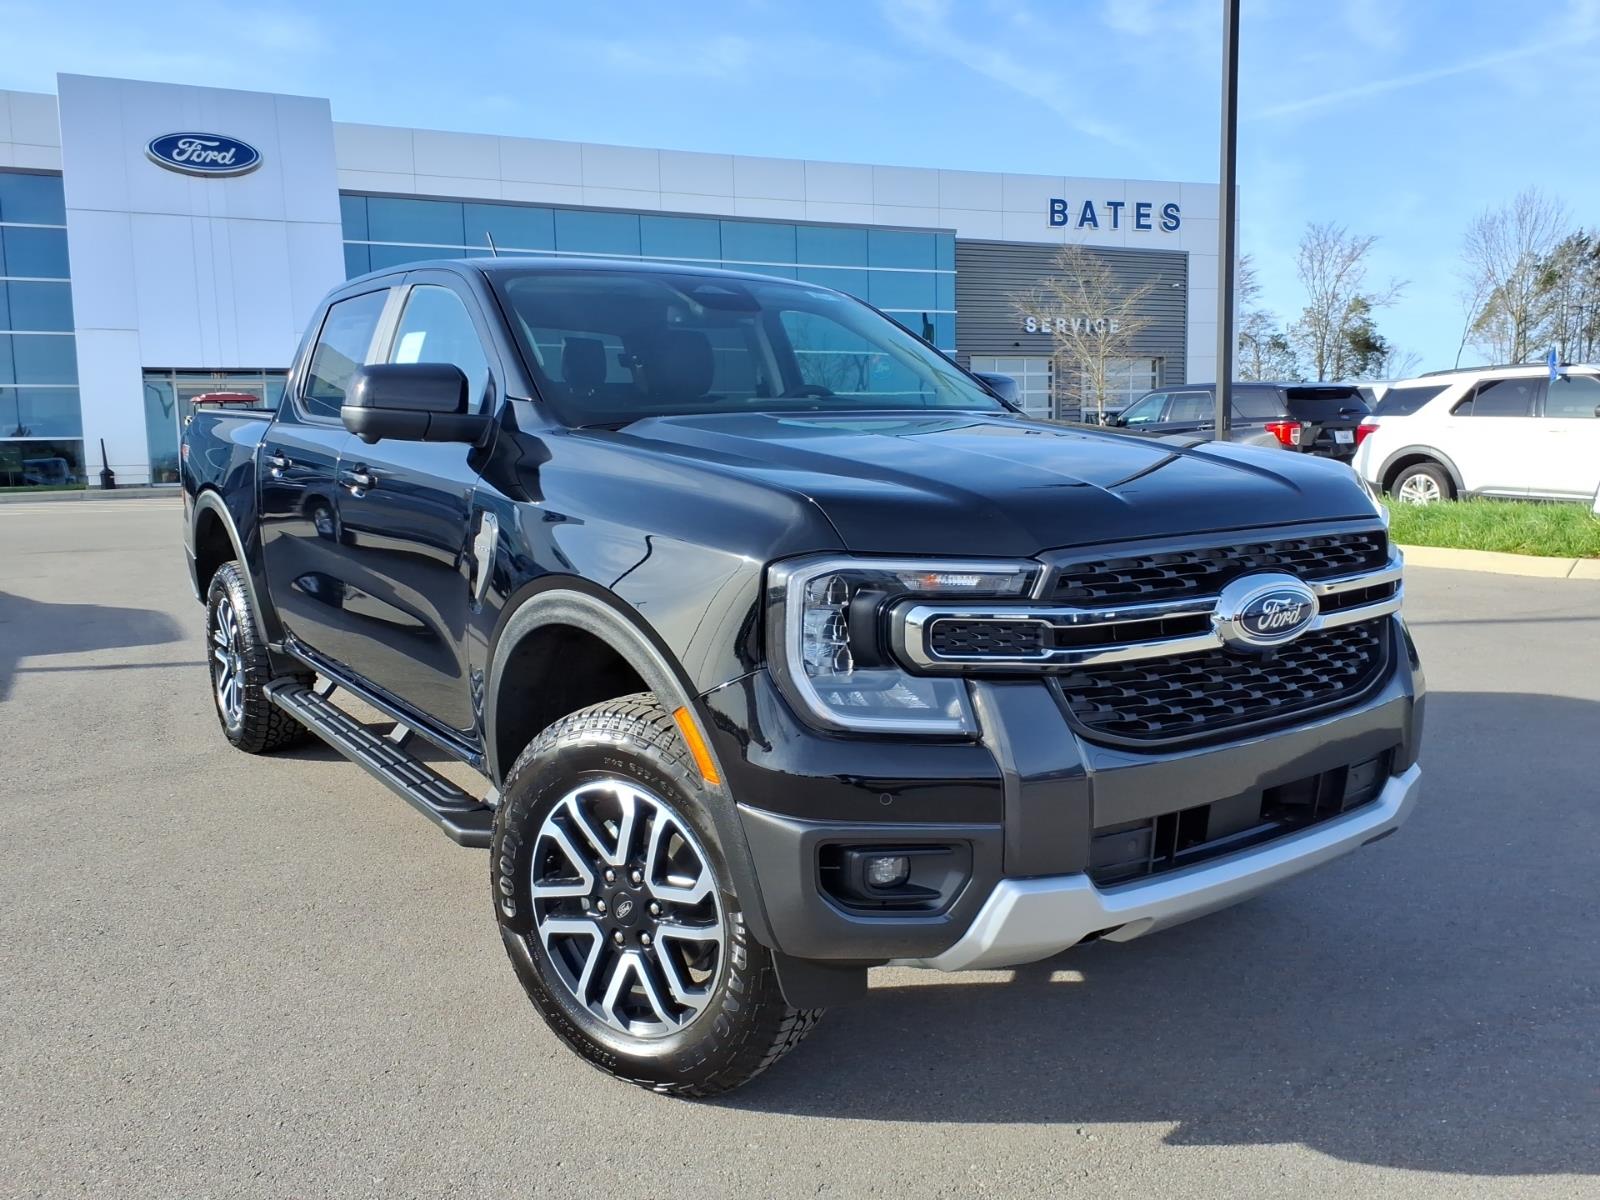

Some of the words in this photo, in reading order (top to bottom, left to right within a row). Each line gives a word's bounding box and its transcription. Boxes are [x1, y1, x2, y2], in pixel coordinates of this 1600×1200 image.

[172, 138, 237, 165] Ford
[1049, 198, 1181, 232] BATES
[1025, 316, 1120, 333] SERVICE
[1258, 598, 1302, 630] Ford
